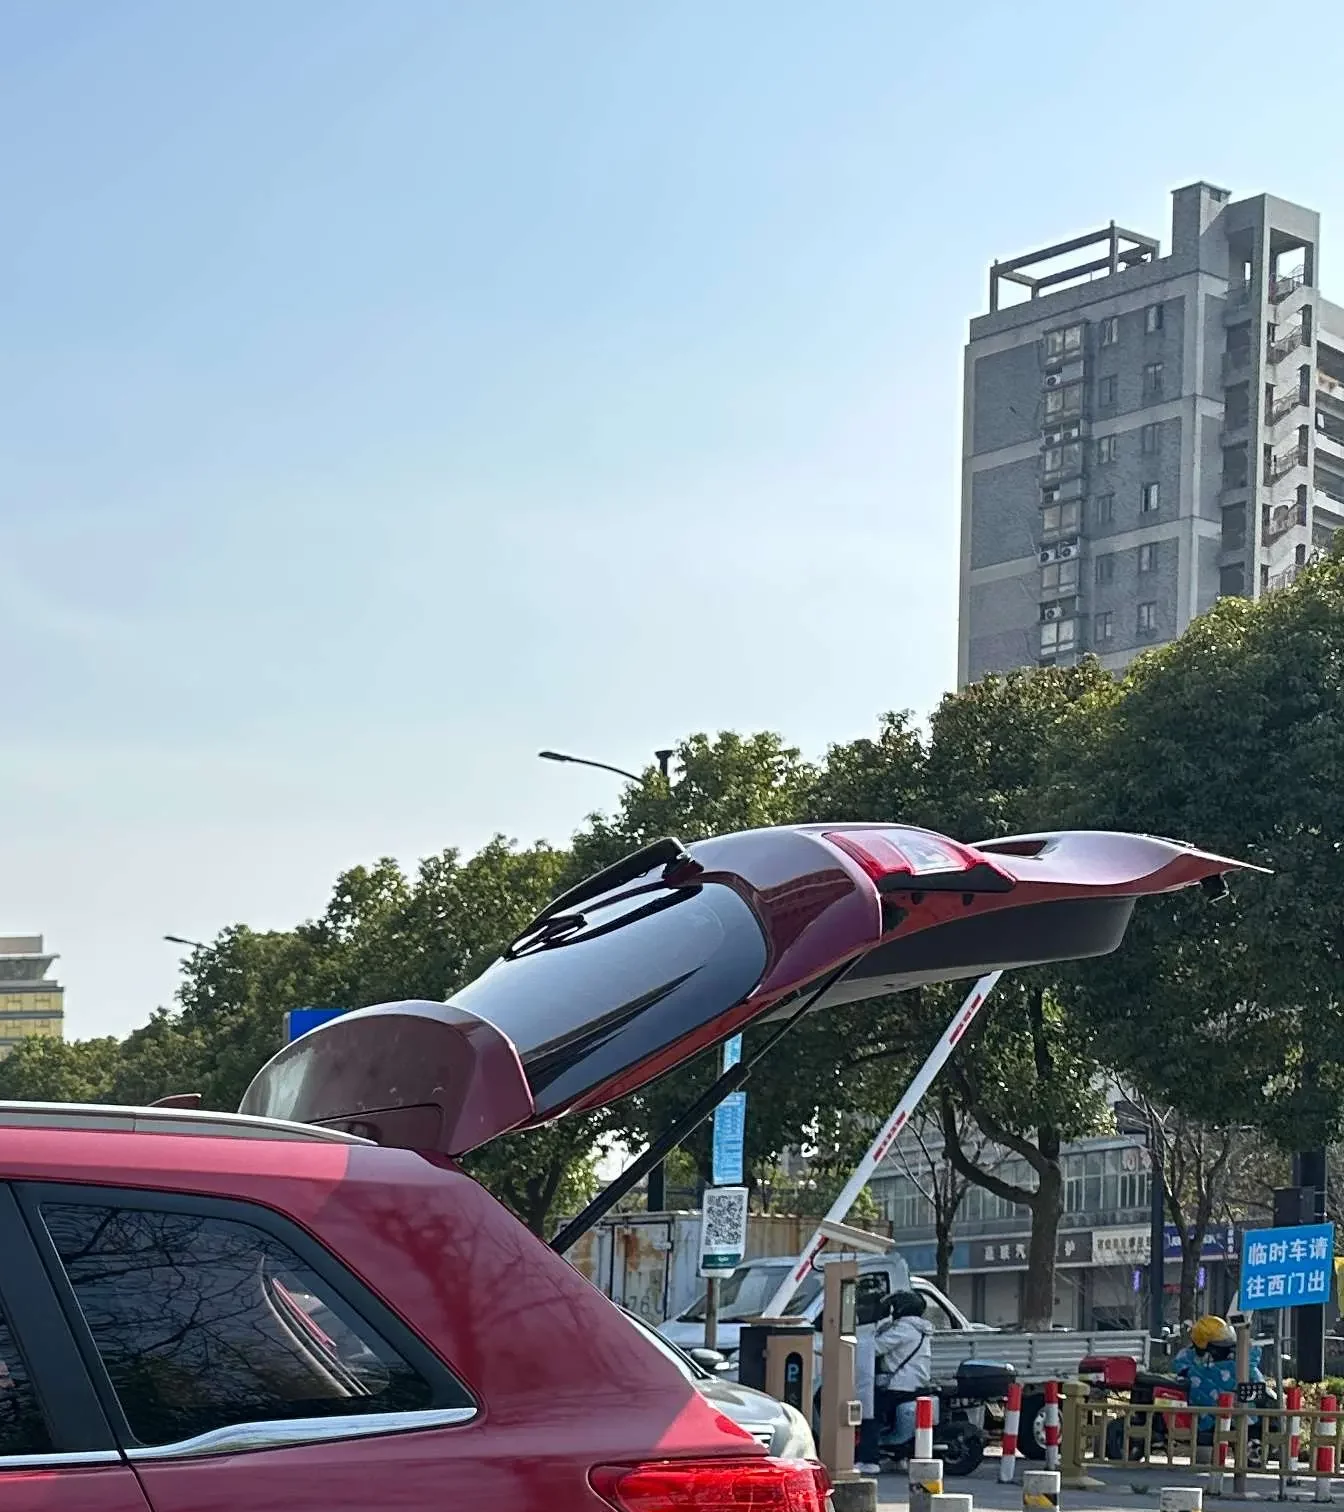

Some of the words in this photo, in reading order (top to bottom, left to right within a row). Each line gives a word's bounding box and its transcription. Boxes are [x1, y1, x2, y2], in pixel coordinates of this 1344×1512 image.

[1247, 1236, 1329, 1266] 临时车请
[1246, 1269, 1325, 1299] 往西门出
